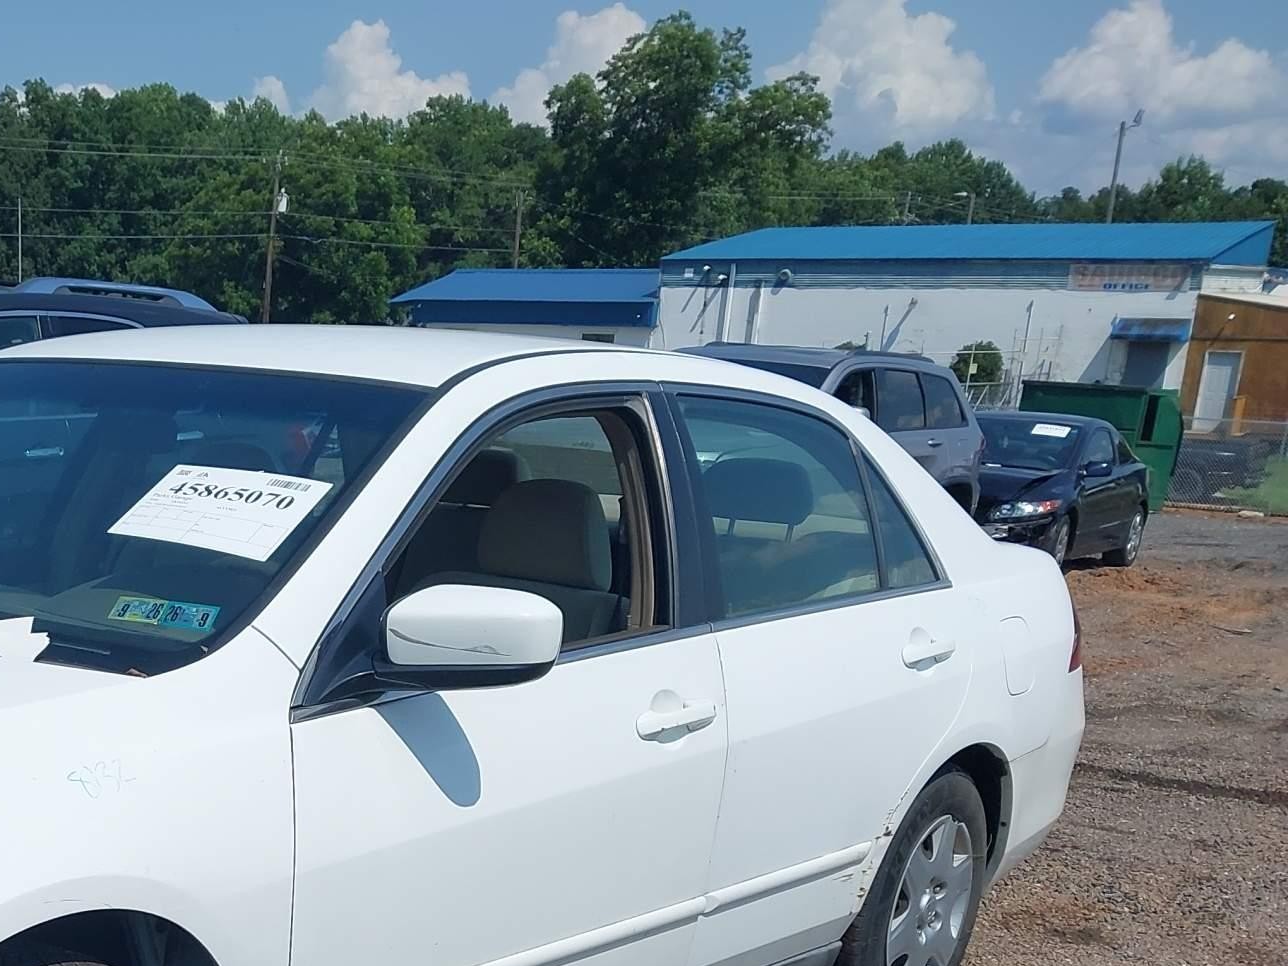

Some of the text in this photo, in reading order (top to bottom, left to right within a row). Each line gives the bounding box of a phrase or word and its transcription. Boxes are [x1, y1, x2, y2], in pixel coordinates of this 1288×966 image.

[169, 481, 295, 510] 45865070
[117, 603, 165, 620] 9 26
[165, 605, 210, 627] 26 9
